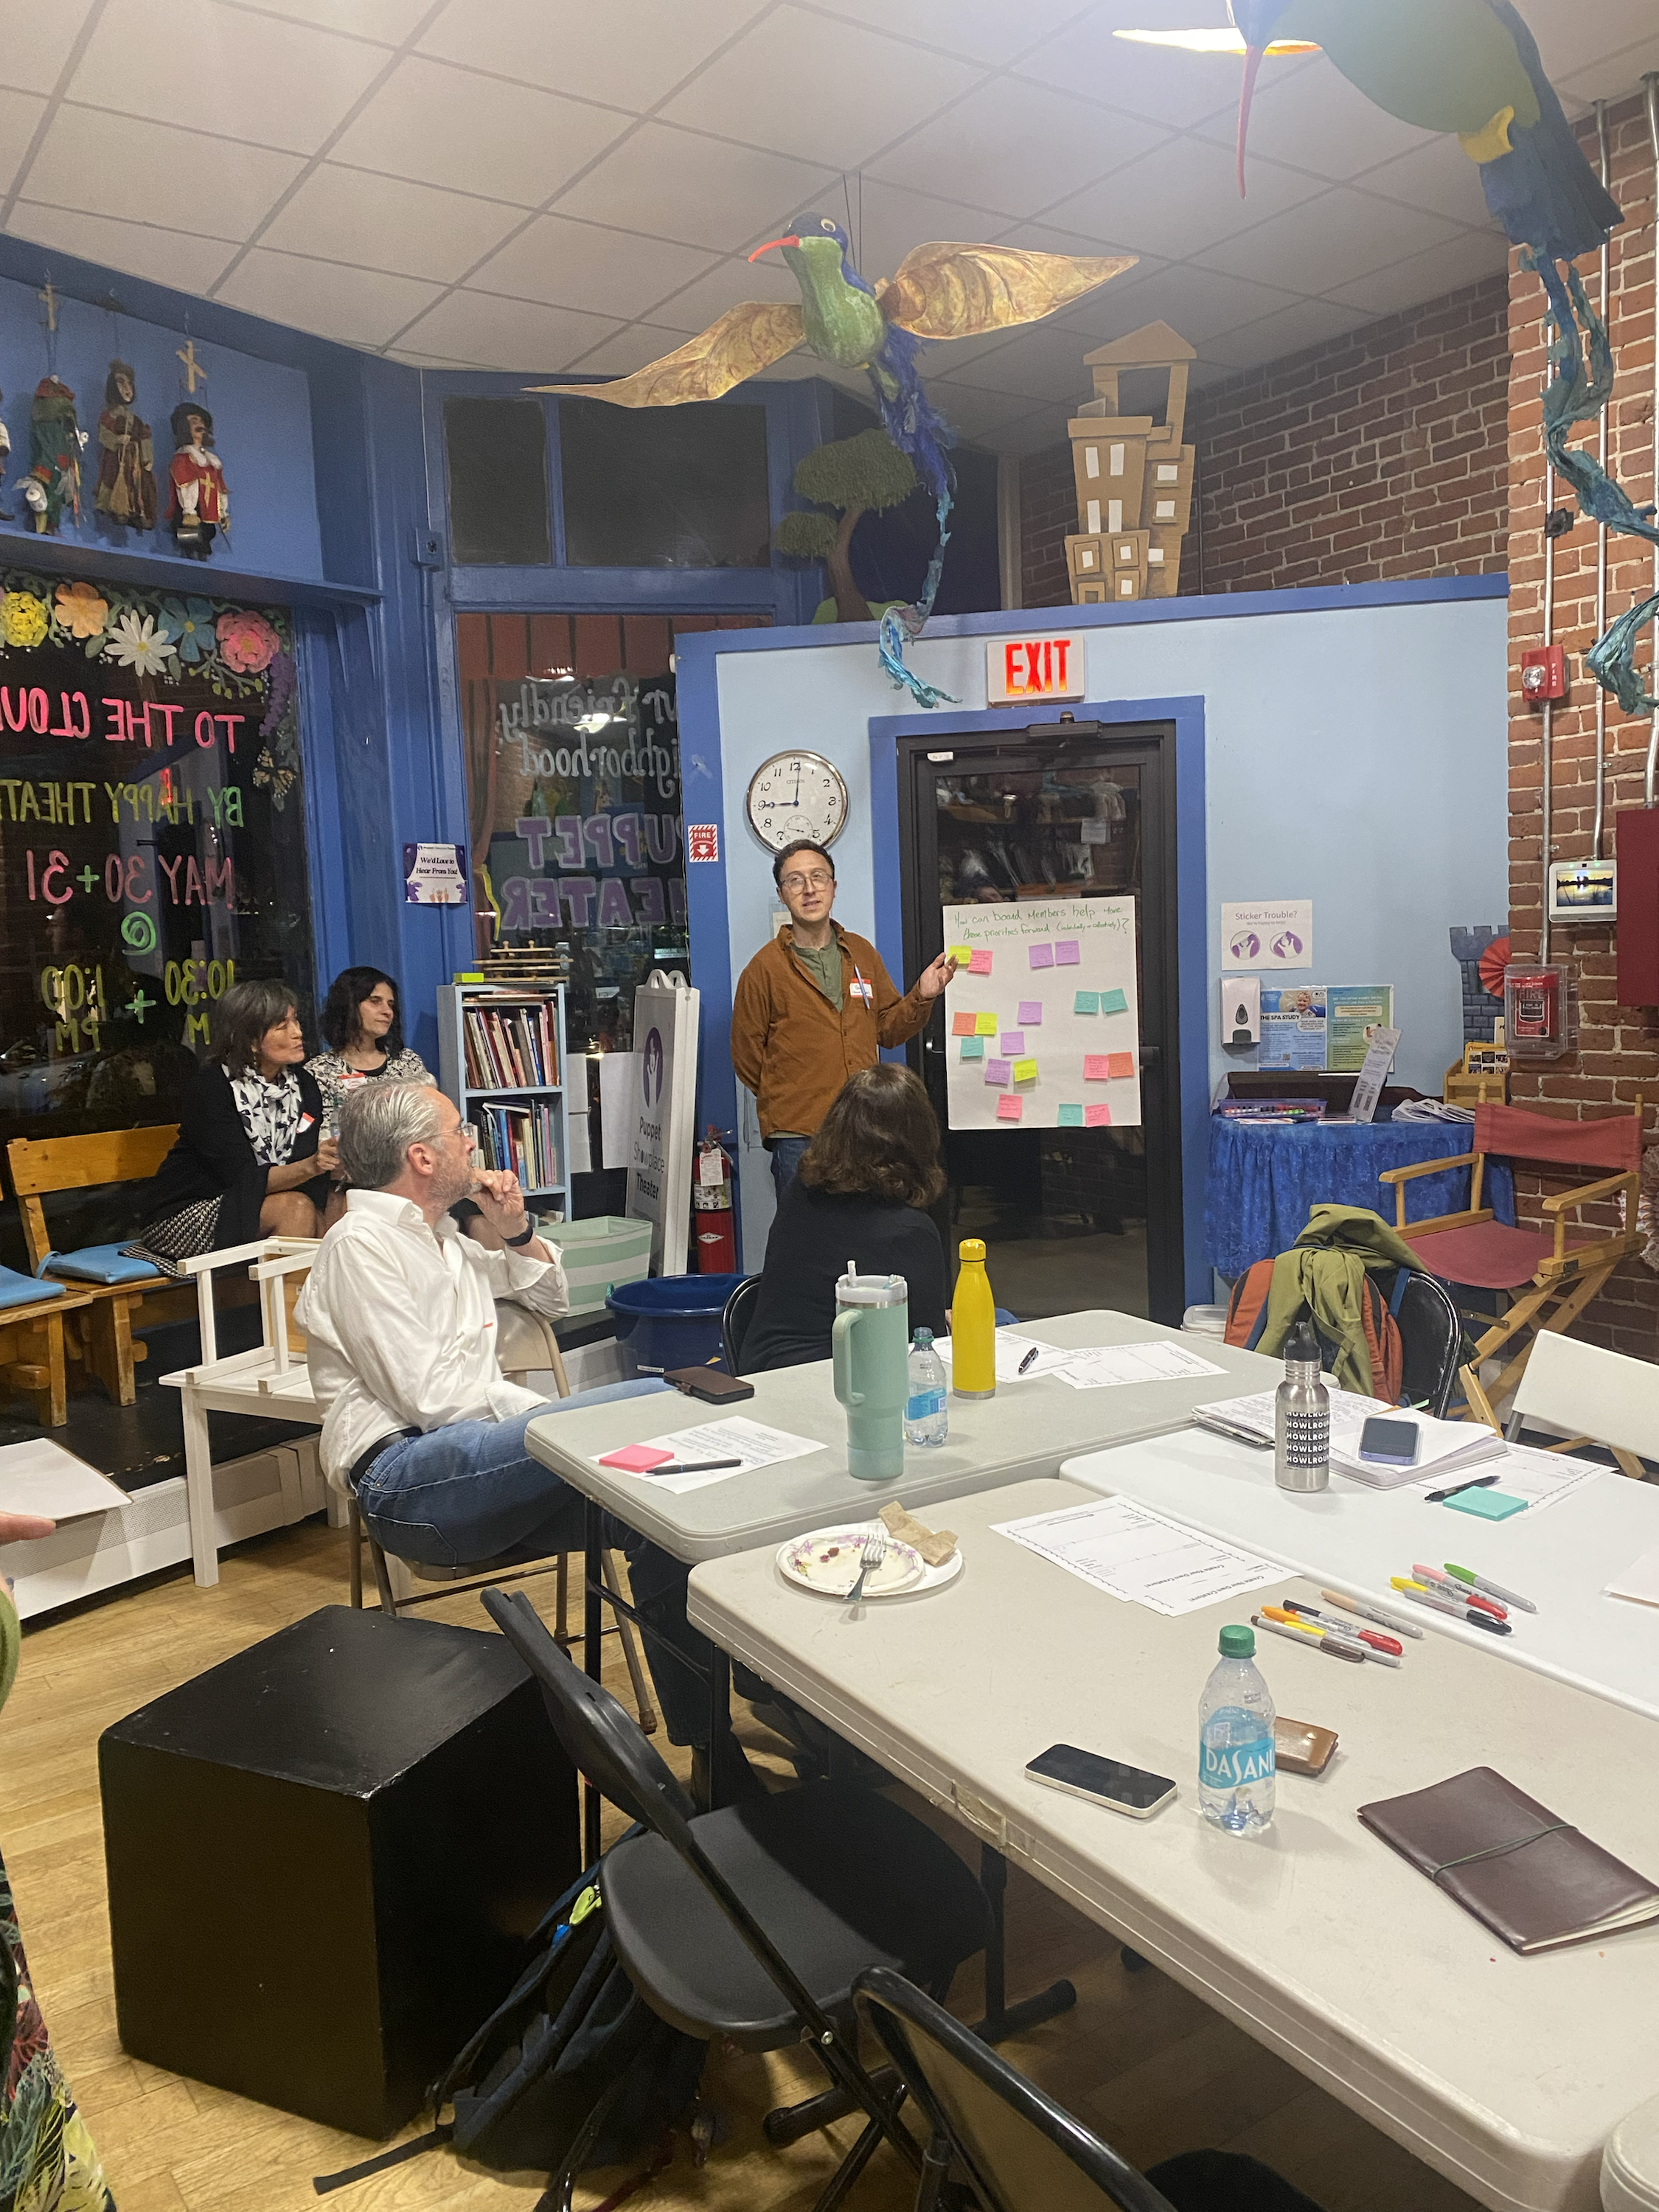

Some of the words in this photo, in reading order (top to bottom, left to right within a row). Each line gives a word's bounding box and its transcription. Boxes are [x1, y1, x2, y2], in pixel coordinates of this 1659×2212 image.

[1005, 640, 1071, 695] EXIT
[790, 762, 801, 771] 12
[774, 768, 782, 776] 11
[761, 782, 771, 791] 10
[823, 779, 830, 787] 2
[758, 800, 766, 810] 9
[828, 796, 836, 806] 3
[764, 818, 772, 828] 8
[824, 814, 832, 825] 4
[776, 831, 784, 841] 7
[813, 830, 820, 838] 5
[954, 911, 967, 928] How
[972, 916, 989, 924] can
[992, 909, 1023, 921] board
[1072, 904, 1096, 919] help
[1235, 912, 1262, 920] Sticker
[1264, 911, 1297, 919] Trouble?
[1519, 989, 1545, 999] FIRE
[639, 1116, 661, 1141] Puppet
[633, 1141, 664, 1174] Showplace
[636, 1172, 659, 1200] Theater
[1205, 1564, 1225, 1572] Create
[1144, 1577, 1174, 1588] Creature!
[1245, 1575, 1265, 1584] Create
[1188, 1590, 1217, 1602] Creature!
[1206, 1748, 1274, 1786] DASANI
